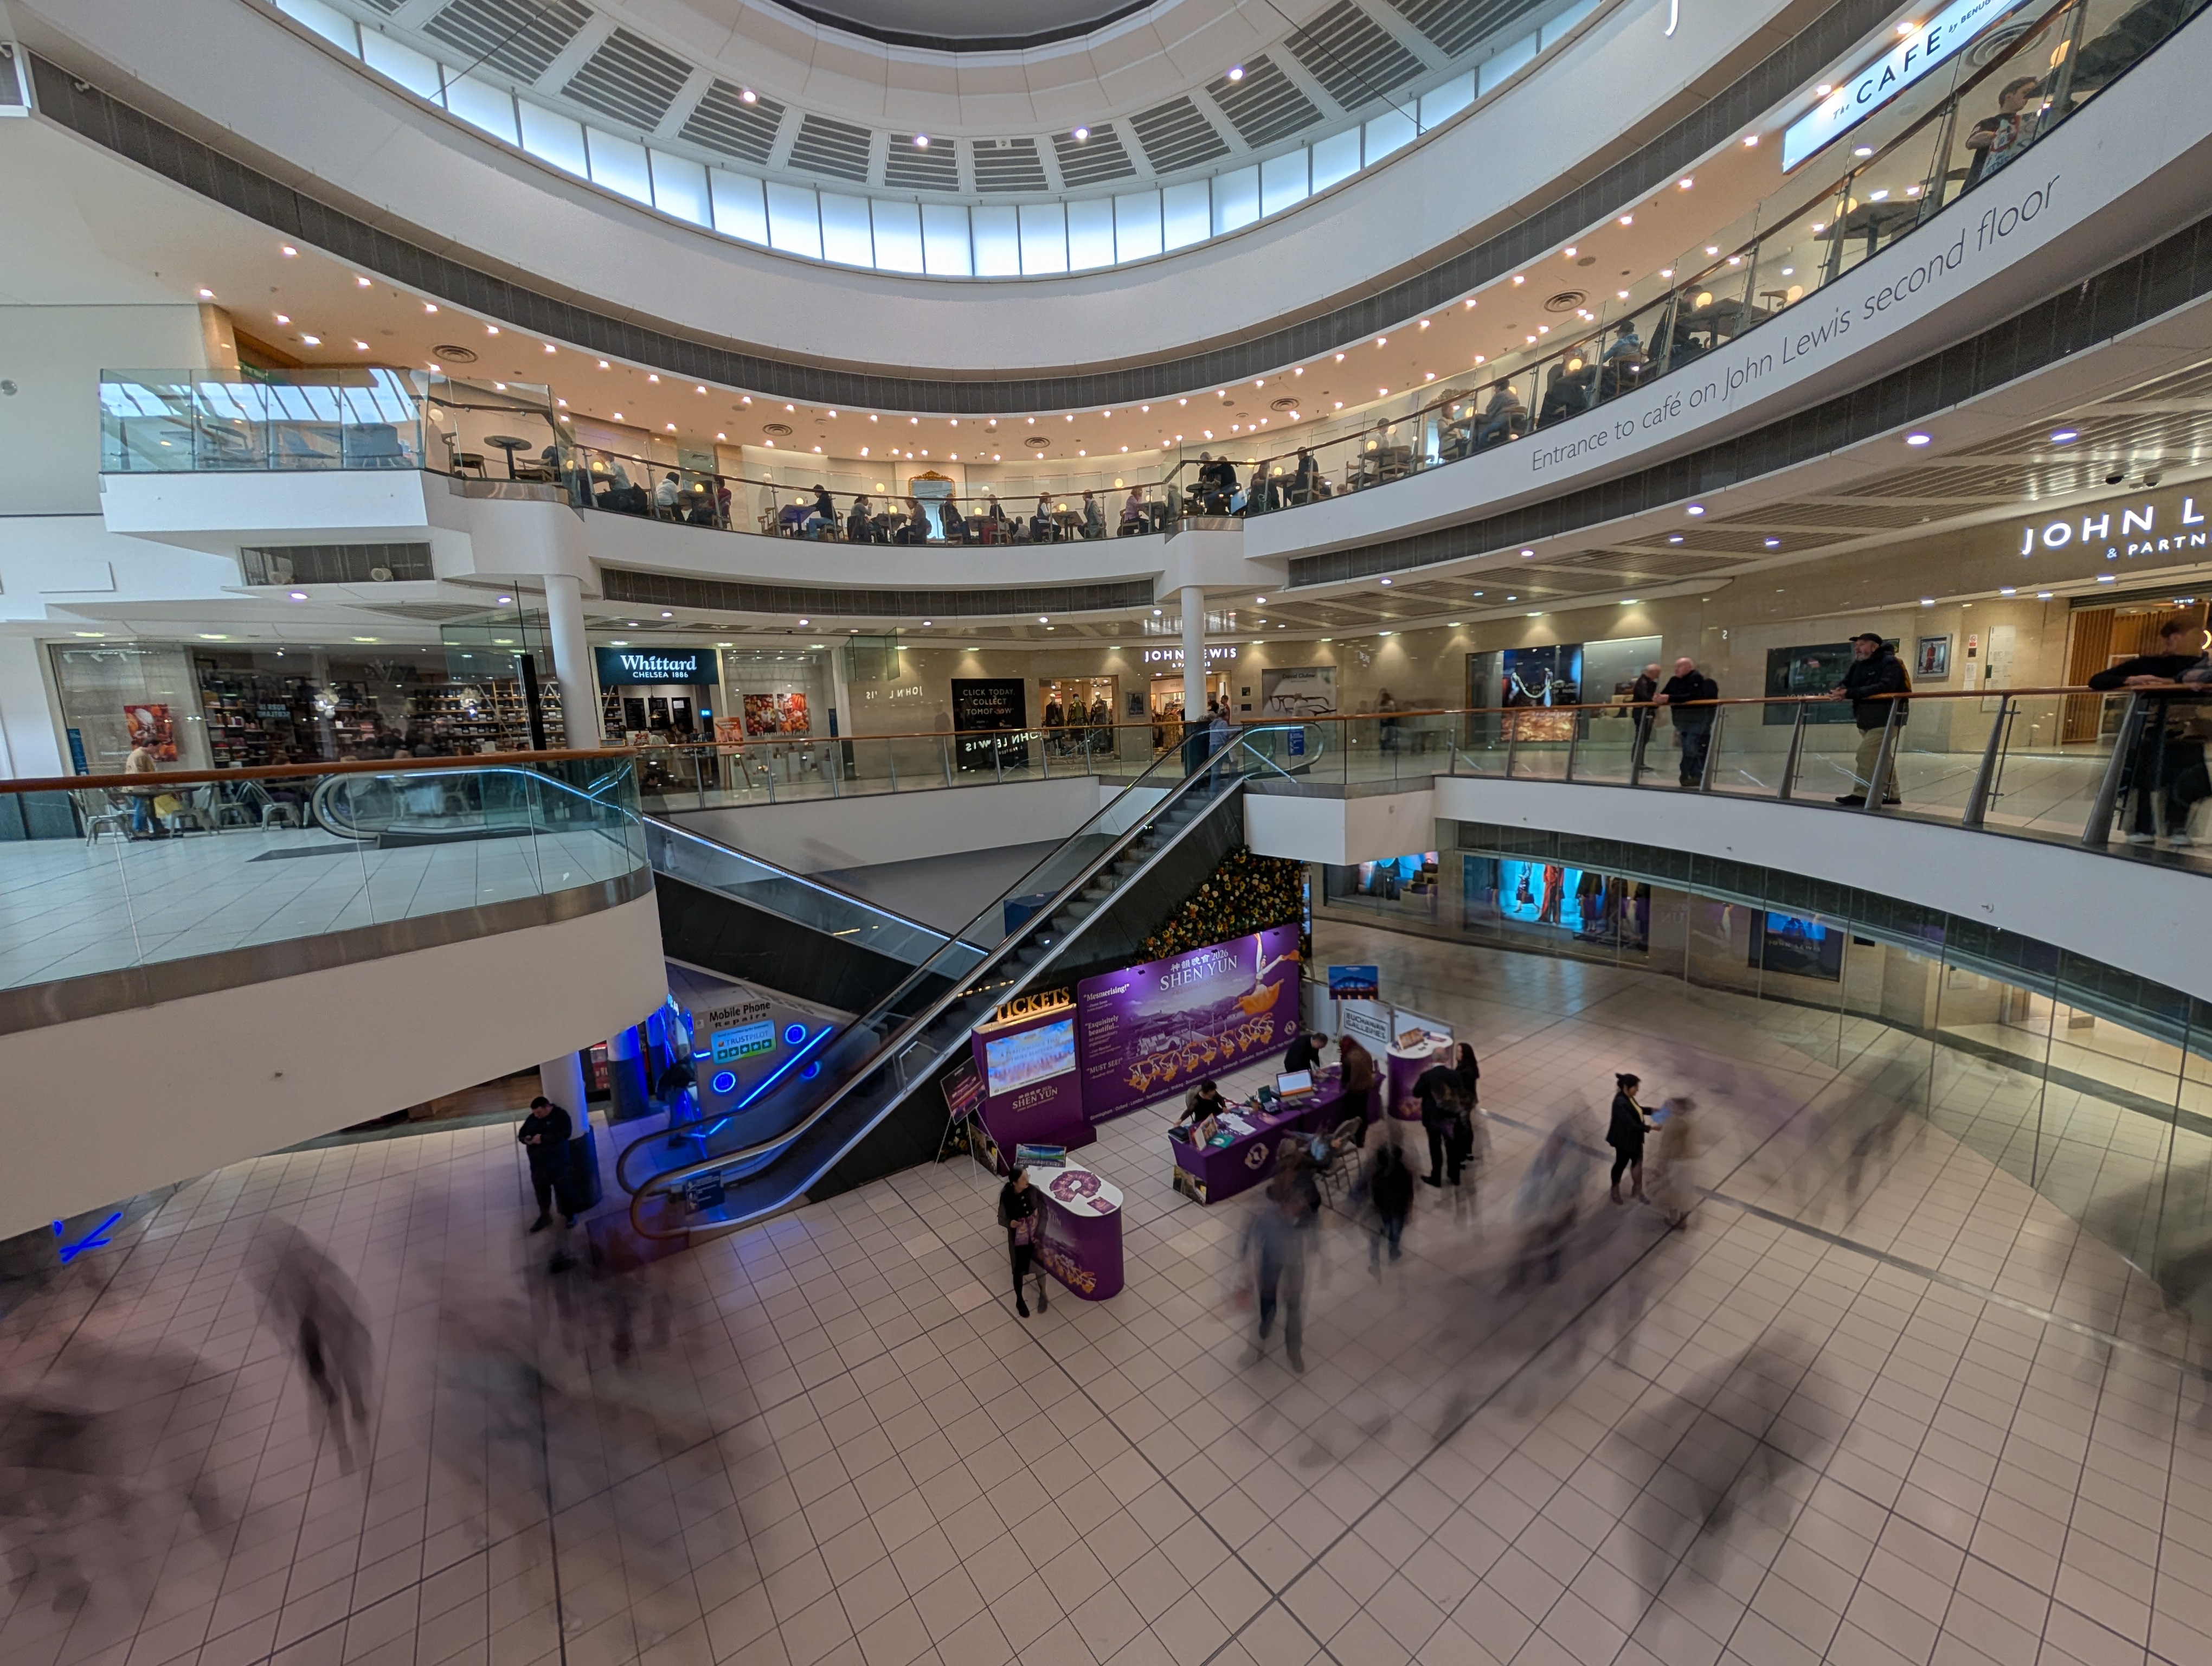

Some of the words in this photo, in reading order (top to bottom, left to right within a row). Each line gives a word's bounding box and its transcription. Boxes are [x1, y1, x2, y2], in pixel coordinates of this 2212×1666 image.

[1856, 26, 1941, 104] CAFE
[1961, 0, 1995, 23] BENUG
[1532, 431, 1607, 471] Entrance
[1614, 420, 1635, 440] to
[1642, 391, 1682, 429] café
[1689, 383, 1716, 408] on
[1722, 354, 1772, 401] John
[1782, 307, 1850, 365] Lewis
[1863, 228, 1966, 320] second
[1978, 175, 2060, 252] floor
[2022, 505, 2154, 555] JOHN
[2106, 548, 2118, 559] &
[2128, 533, 2212, 556] PARTN
[620, 655, 697, 671] Whittard
[1144, 649, 1185, 663] JOHN
[1211, 949, 1229, 961] 2026
[1160, 965, 1204, 991] SHEN
[1207, 955, 1237, 976] YUN
[709, 1007, 741, 1022] Mobile
[743, 1002, 770, 1014] Phone
[992, 986, 1070, 1022] TICKETS
[1012, 1094, 1037, 1110] SHEN
[1039, 1087, 1058, 1100] YUN
[1130, 1097, 1144, 1106] London
